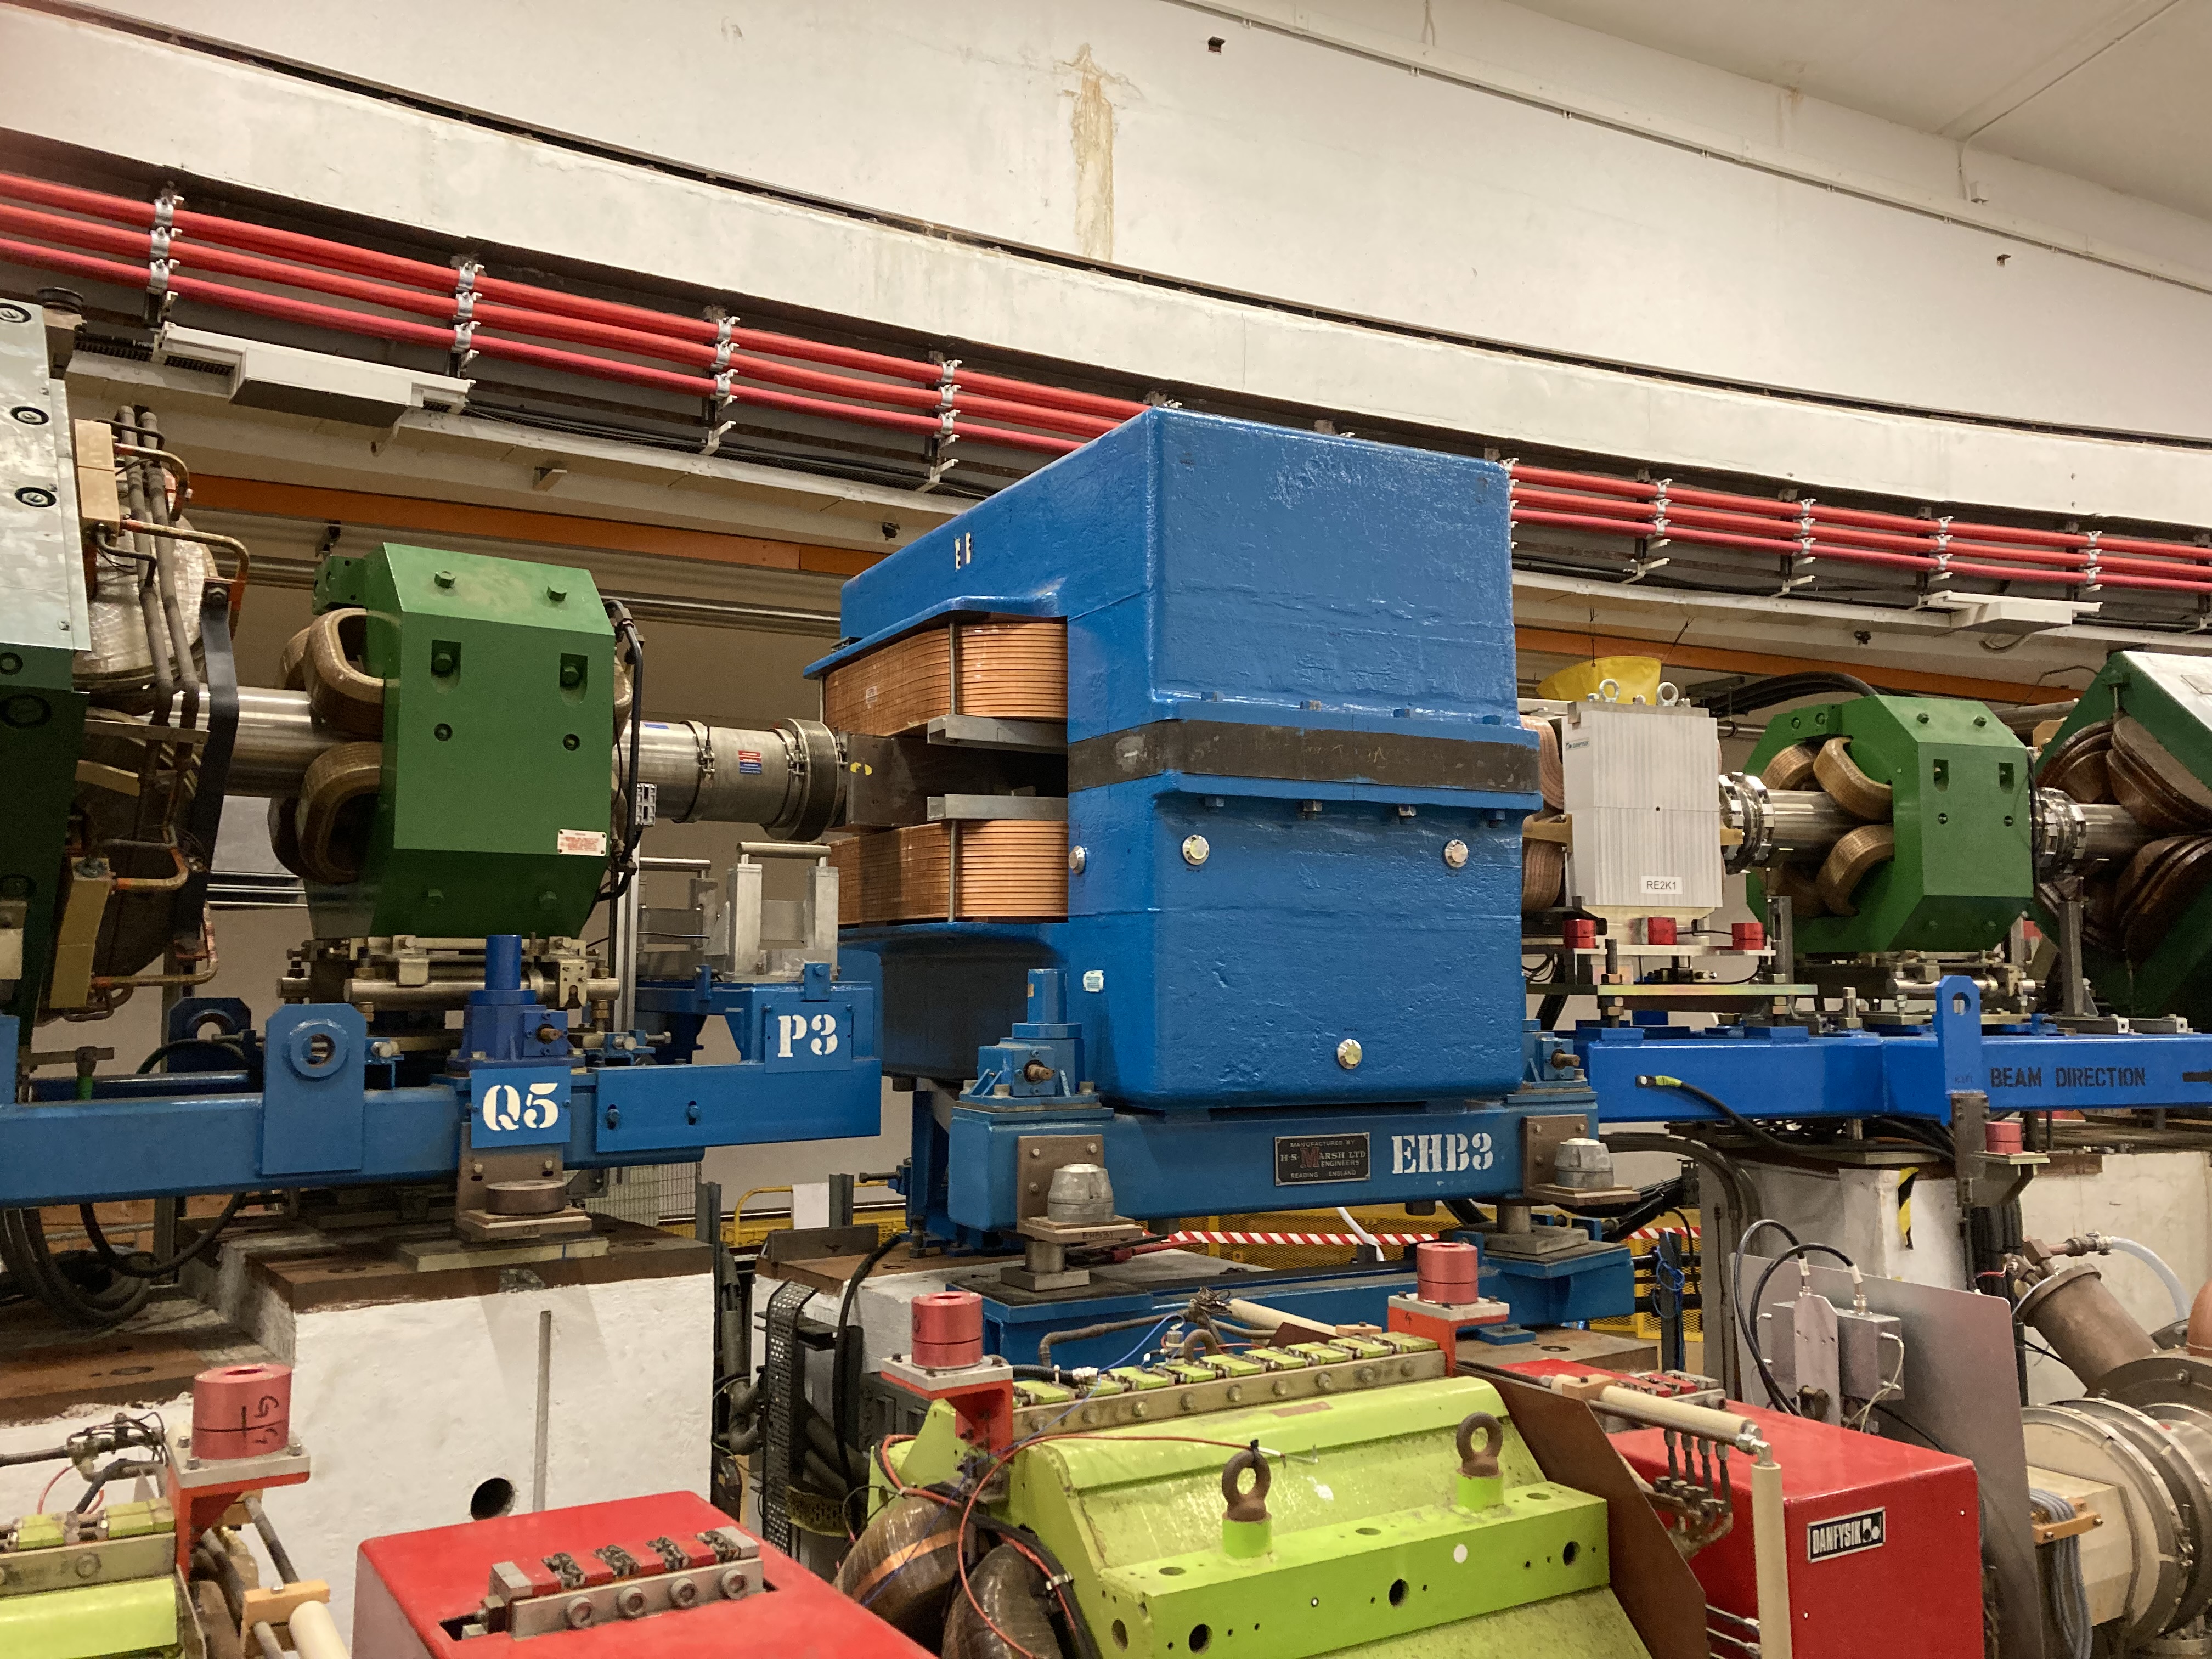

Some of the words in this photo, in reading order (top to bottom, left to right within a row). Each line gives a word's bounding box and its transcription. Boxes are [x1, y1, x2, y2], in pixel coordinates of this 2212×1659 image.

[1646, 881, 1676, 890] RE2K1
[777, 1014, 838, 1057] P3
[1991, 1066, 2041, 1087] BEAM
[2056, 1066, 2146, 1087] DIRECTION
[482, 1082, 559, 1131] Q5
[1321, 1159, 1360, 1167] ENGINEERS
[1391, 1132, 1493, 1174] EHB3
[1813, 1520, 1861, 1555] DANFYSIK
